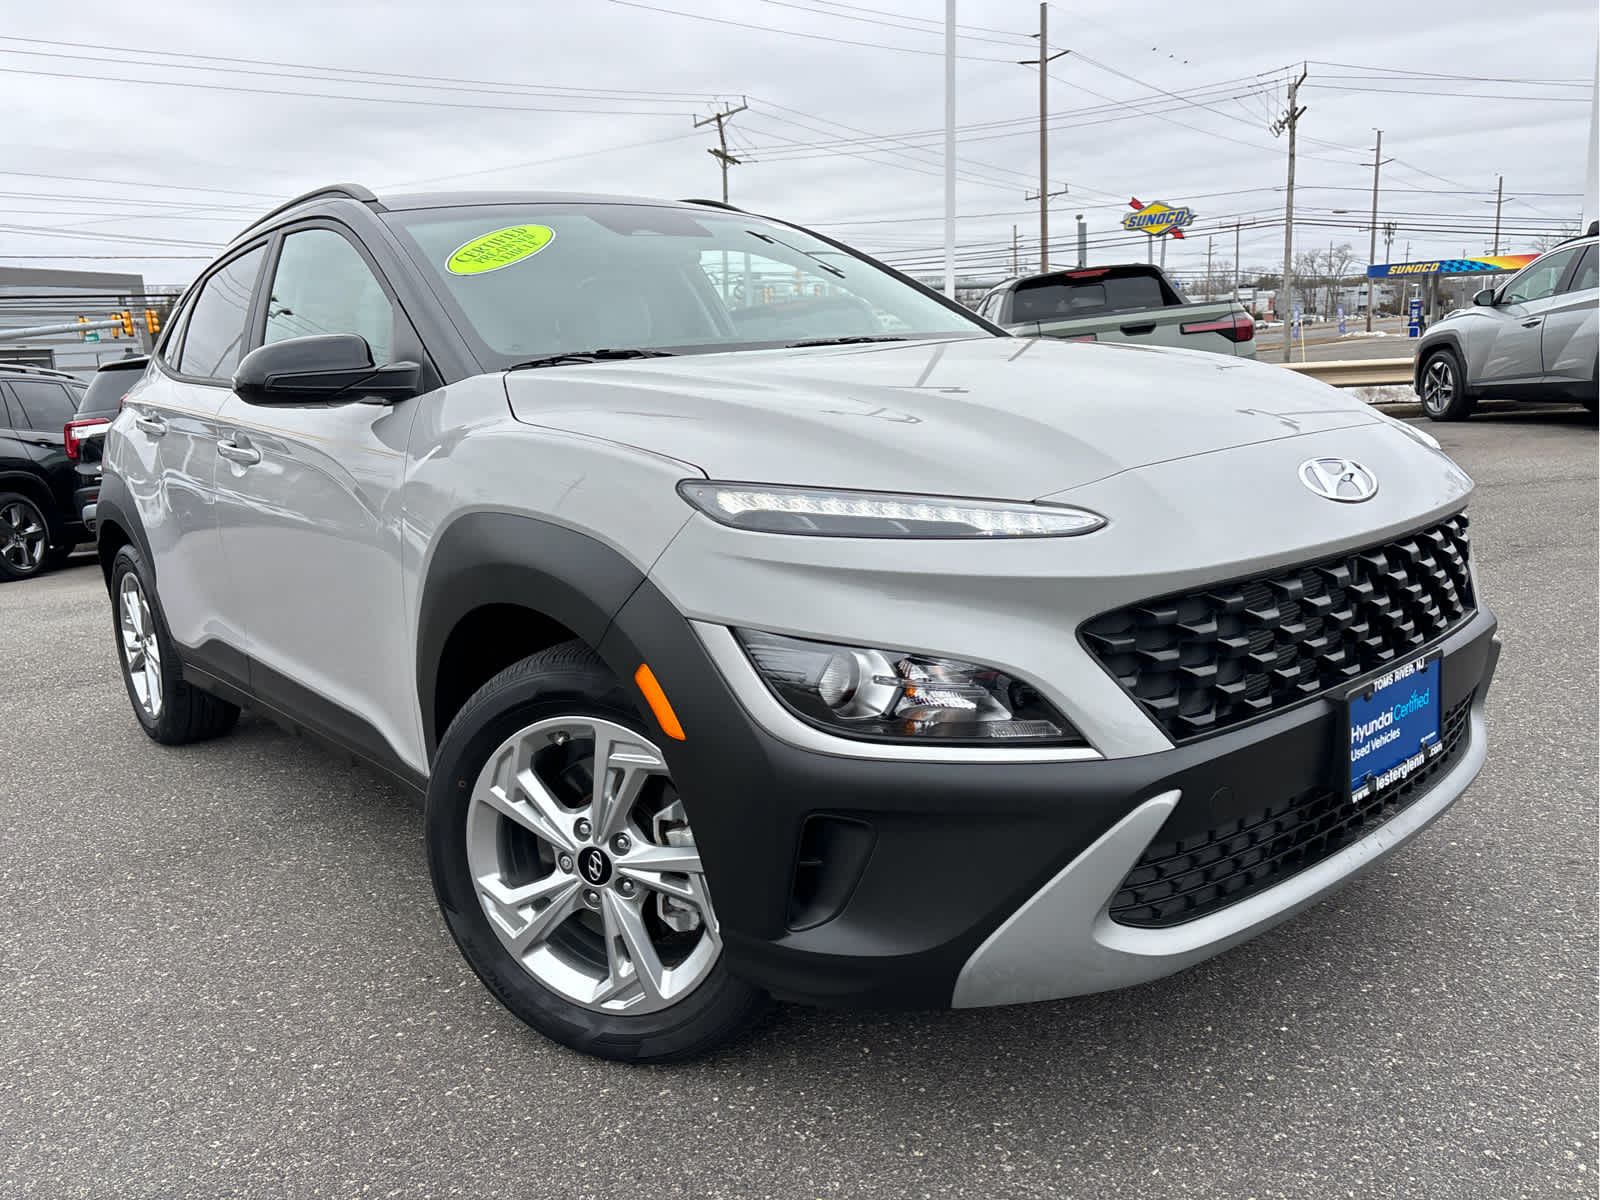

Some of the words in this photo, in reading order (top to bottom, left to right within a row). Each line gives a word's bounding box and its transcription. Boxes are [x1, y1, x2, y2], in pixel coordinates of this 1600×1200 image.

[1127, 211, 1185, 228] SUNOCO
[455, 227, 527, 263] CERTIFIED
[1388, 262, 1440, 275] SUNOCO
[1373, 673, 1394, 692] TOMS
[1416, 657, 1425, 671] NJ
[1351, 706, 1393, 745] Hyundai
[1393, 688, 1430, 721] Certified
[1351, 741, 1370, 761] Used
[1370, 727, 1401, 751] Vehicles
[1376, 753, 1425, 791] lesterglenn
